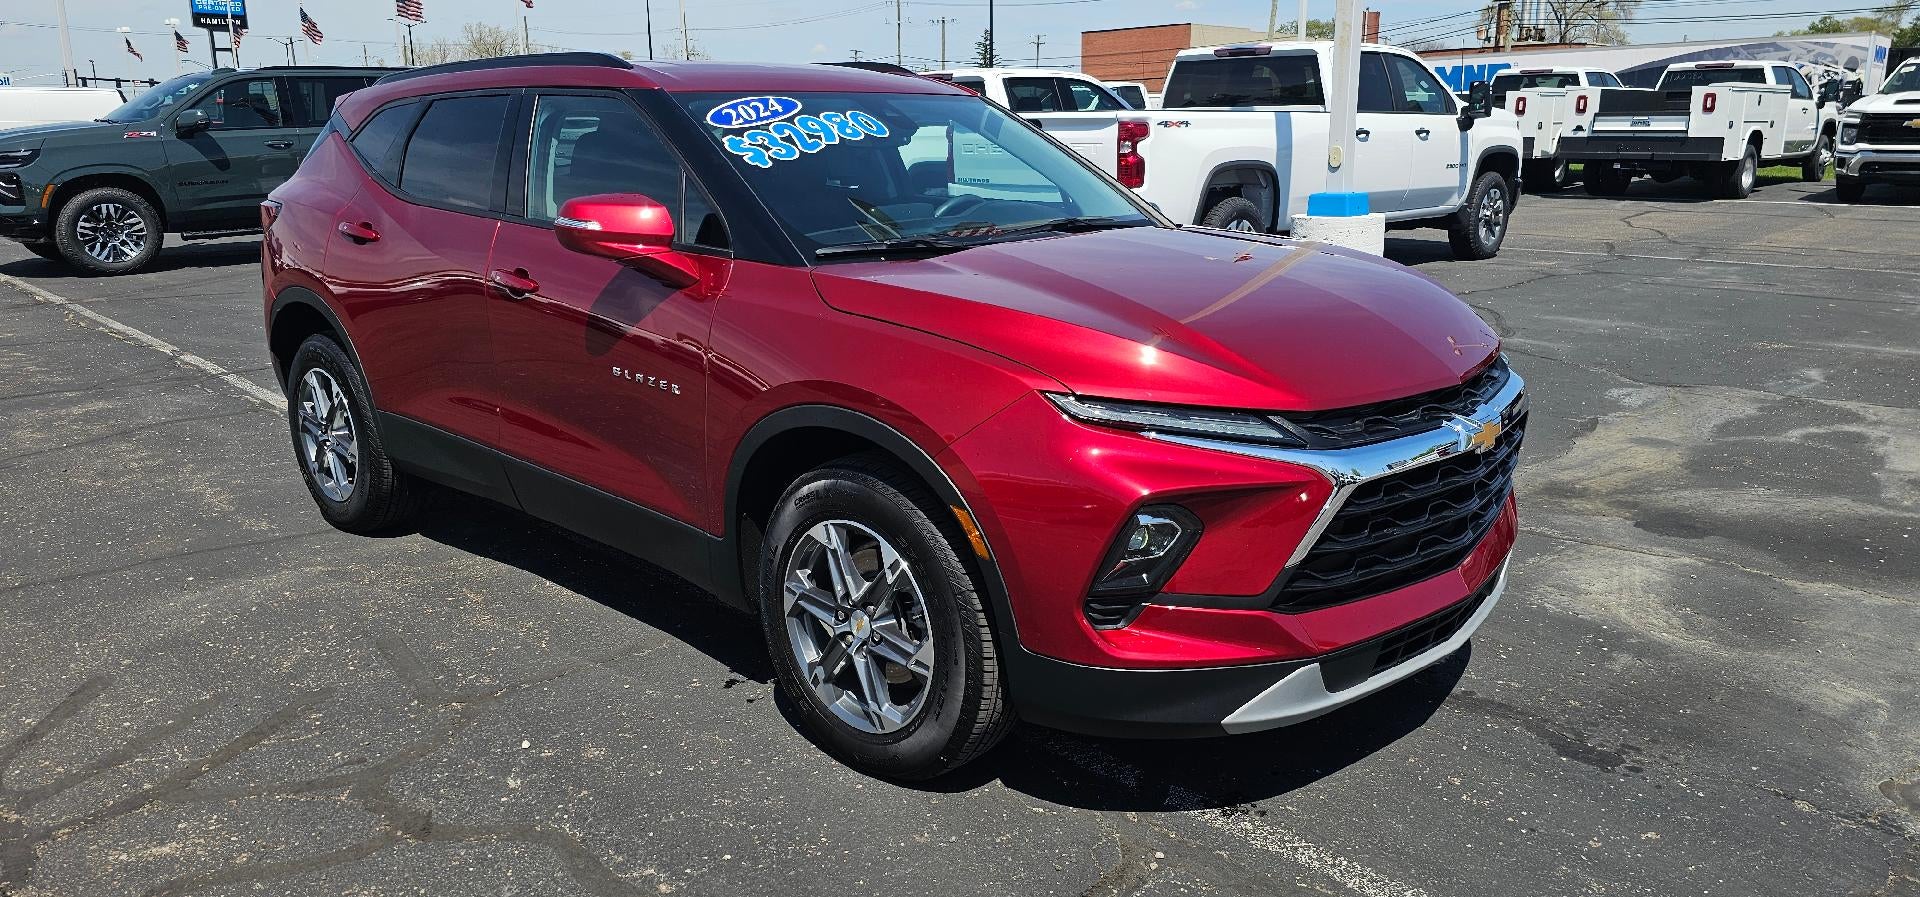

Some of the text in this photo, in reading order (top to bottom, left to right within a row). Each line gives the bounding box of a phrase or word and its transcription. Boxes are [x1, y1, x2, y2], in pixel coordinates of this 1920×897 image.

[722, 97, 784, 126] 2024
[721, 110, 889, 168] $32980
[612, 366, 681, 395] BLAZER
